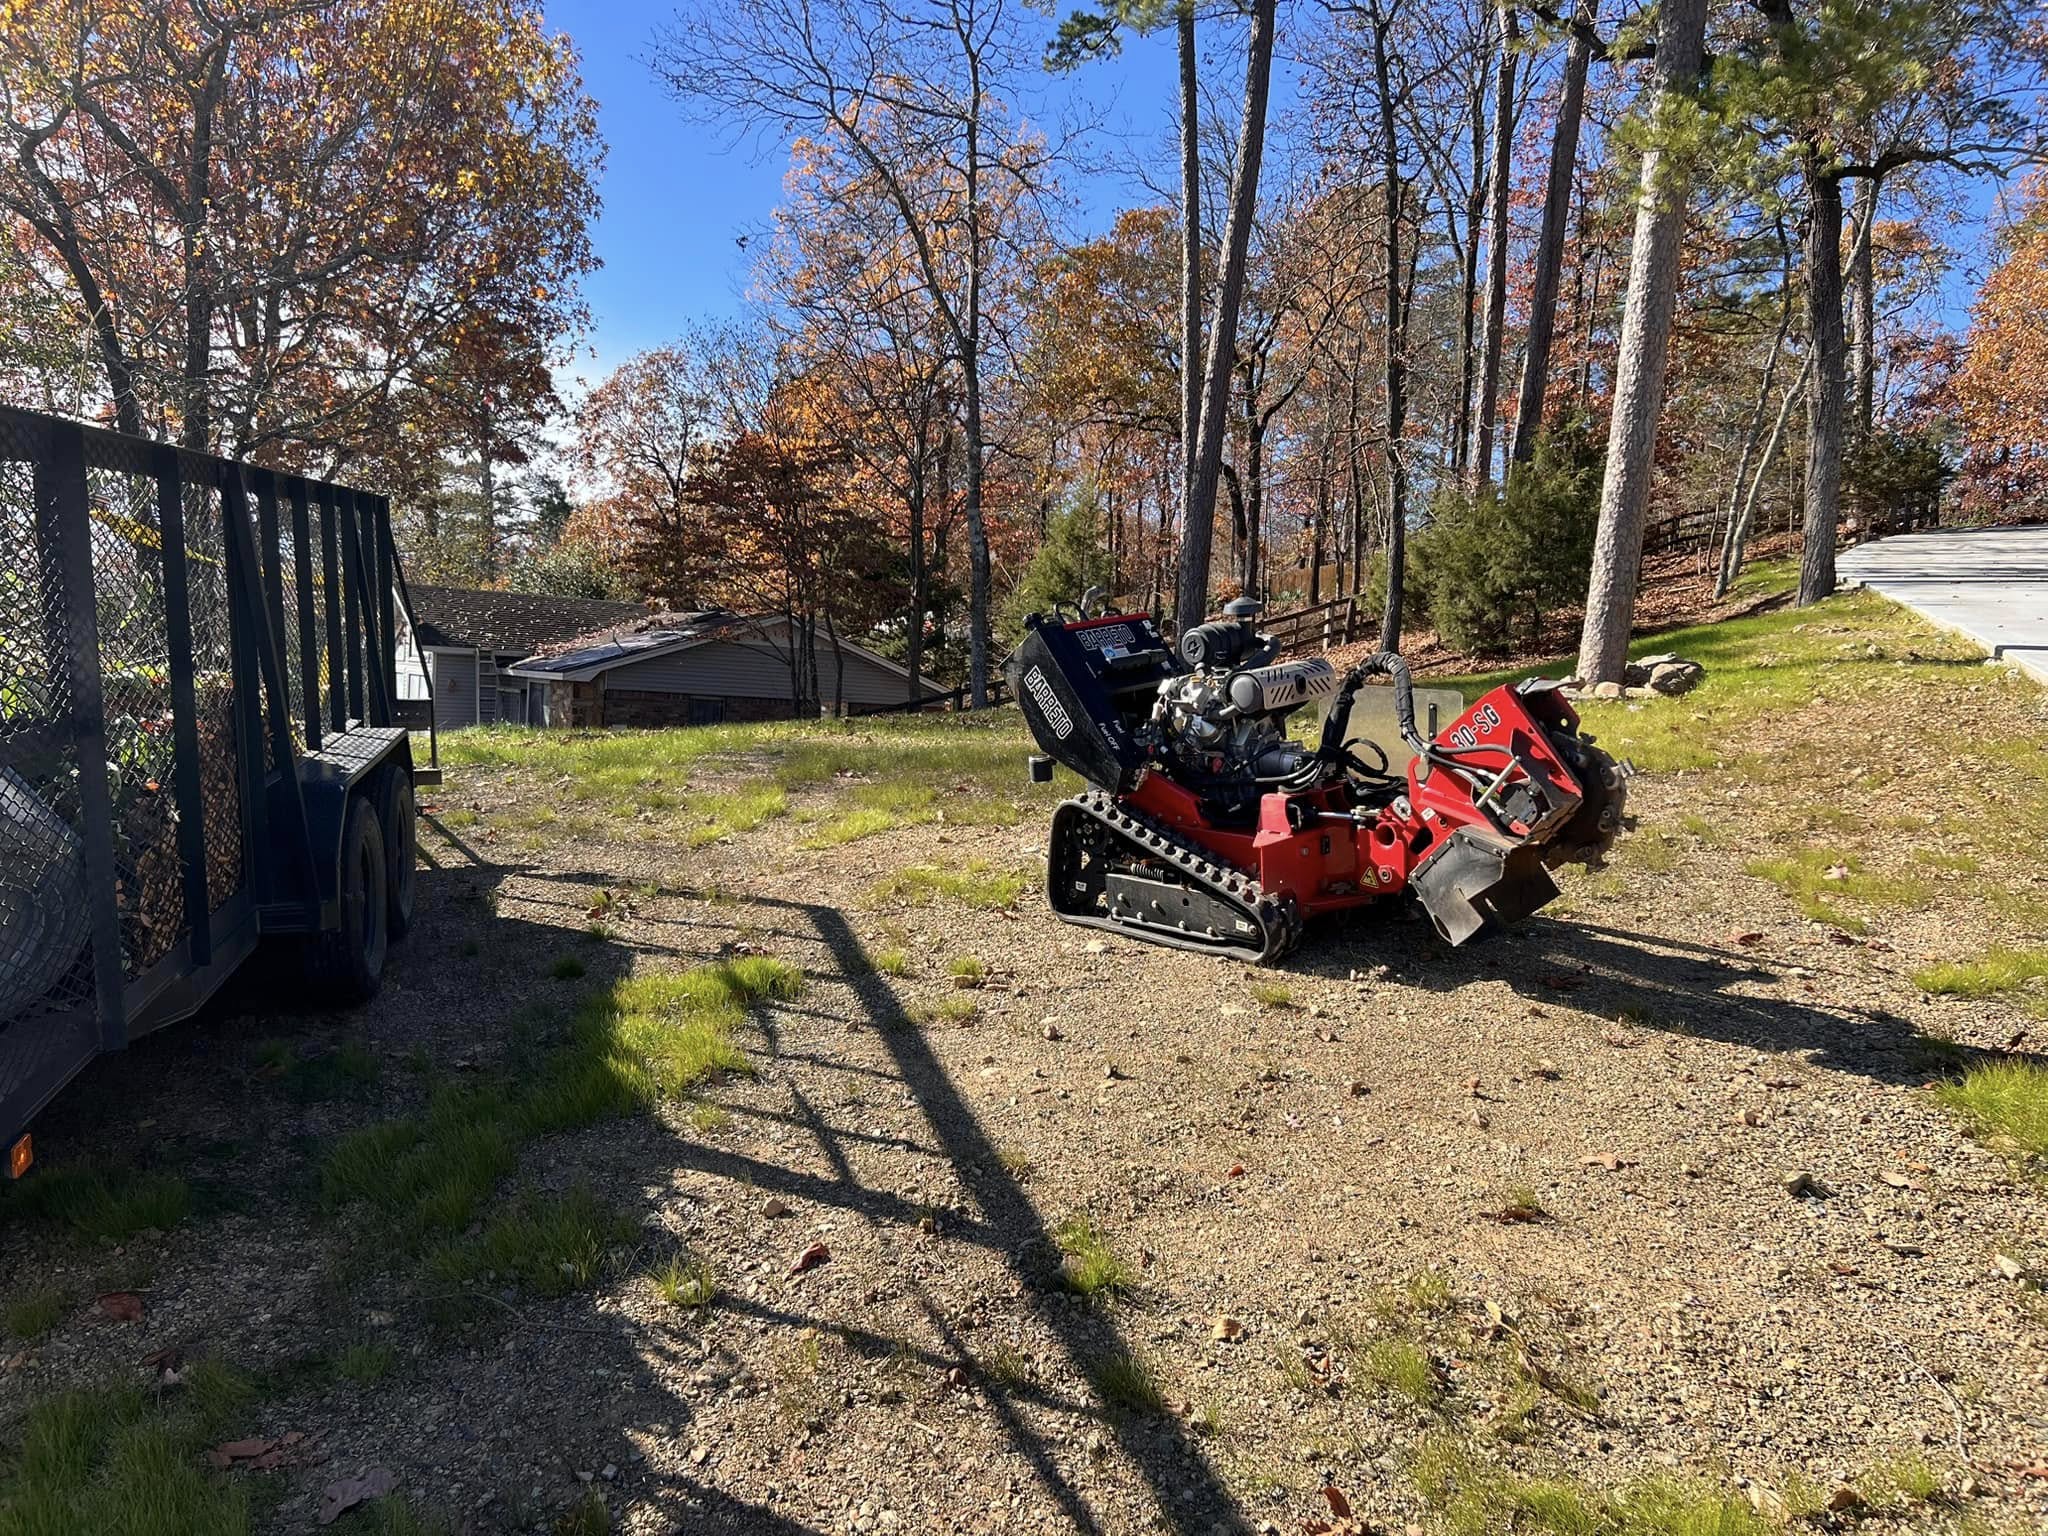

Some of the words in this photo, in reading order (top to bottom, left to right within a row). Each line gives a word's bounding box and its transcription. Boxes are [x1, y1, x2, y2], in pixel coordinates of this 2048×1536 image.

[1076, 624, 1136, 651] BARRETO
[1024, 665, 1073, 740] BARRETO
[1450, 703, 1501, 748] 30-SG
